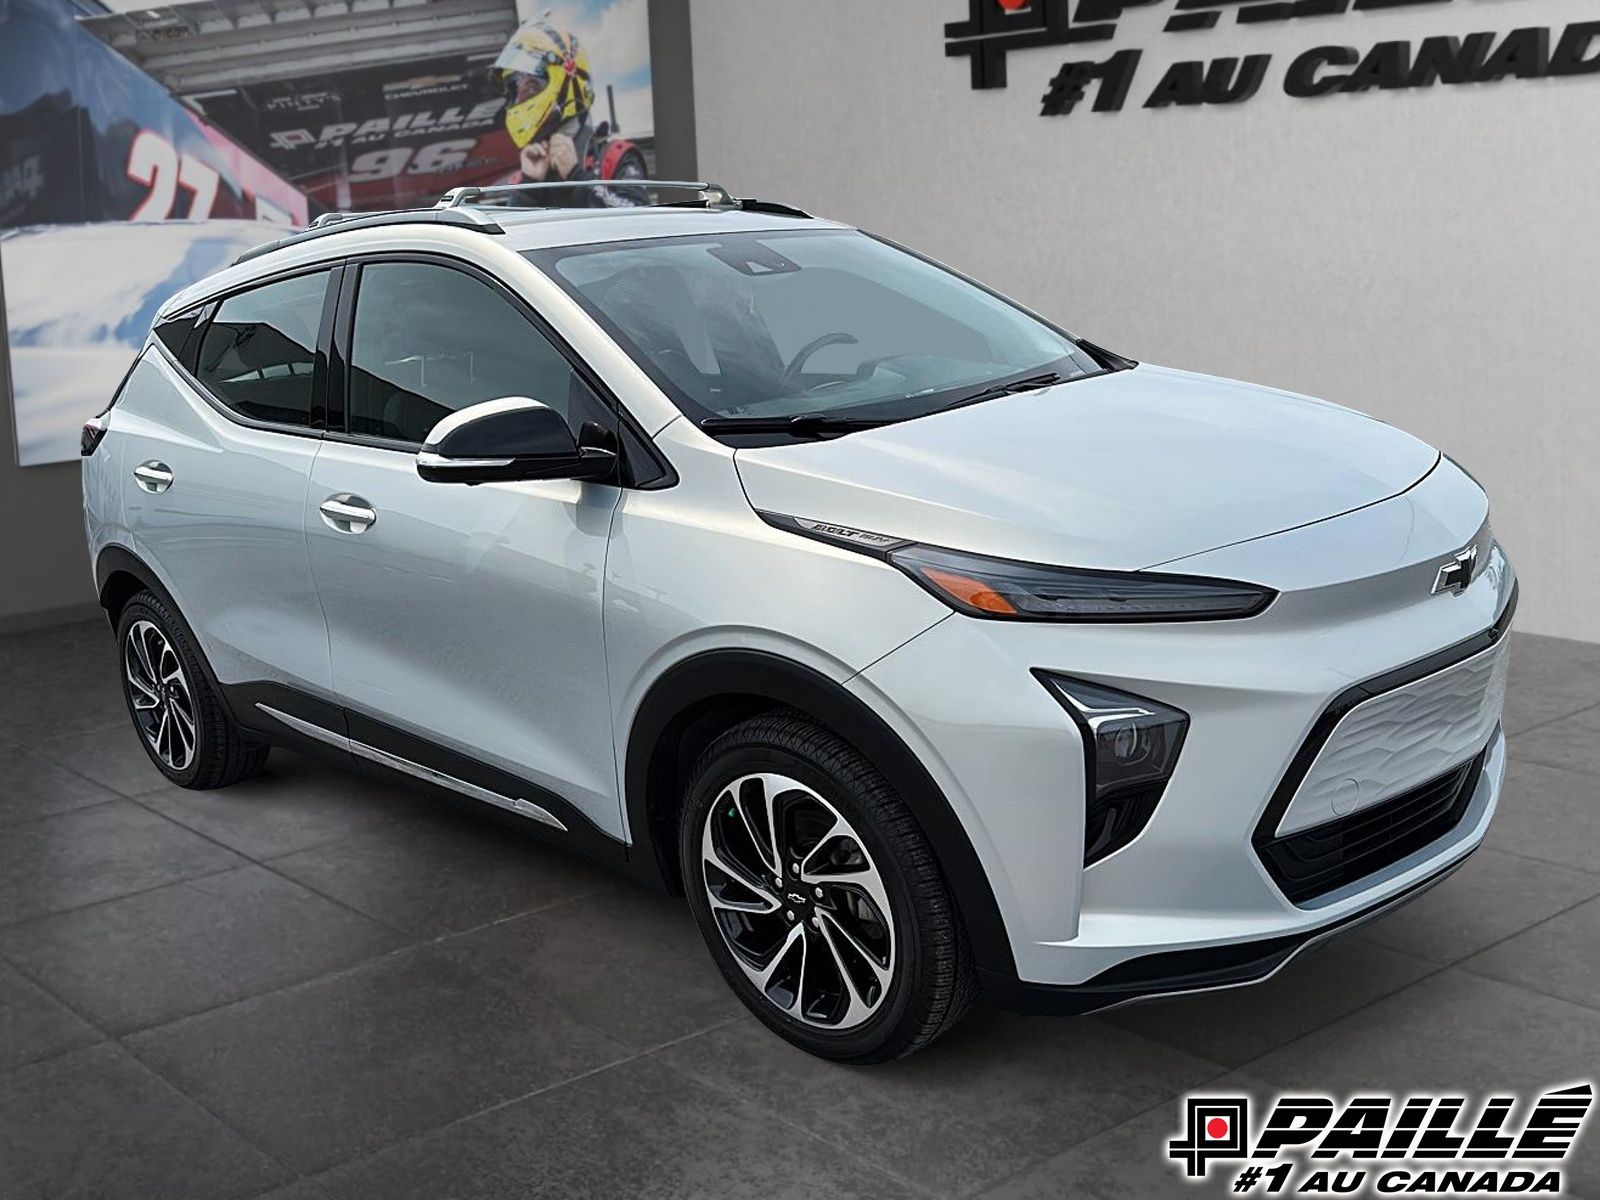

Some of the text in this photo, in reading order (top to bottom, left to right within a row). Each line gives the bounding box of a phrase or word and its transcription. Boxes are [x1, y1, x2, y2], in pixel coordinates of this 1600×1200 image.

[1040, 48, 1143, 117] #1
[1142, 53, 1273, 109] AU
[394, 118, 494, 138] CANADA
[127, 129, 219, 221] 27
[347, 139, 477, 183] 96
[812, 524, 859, 536] BOLT
